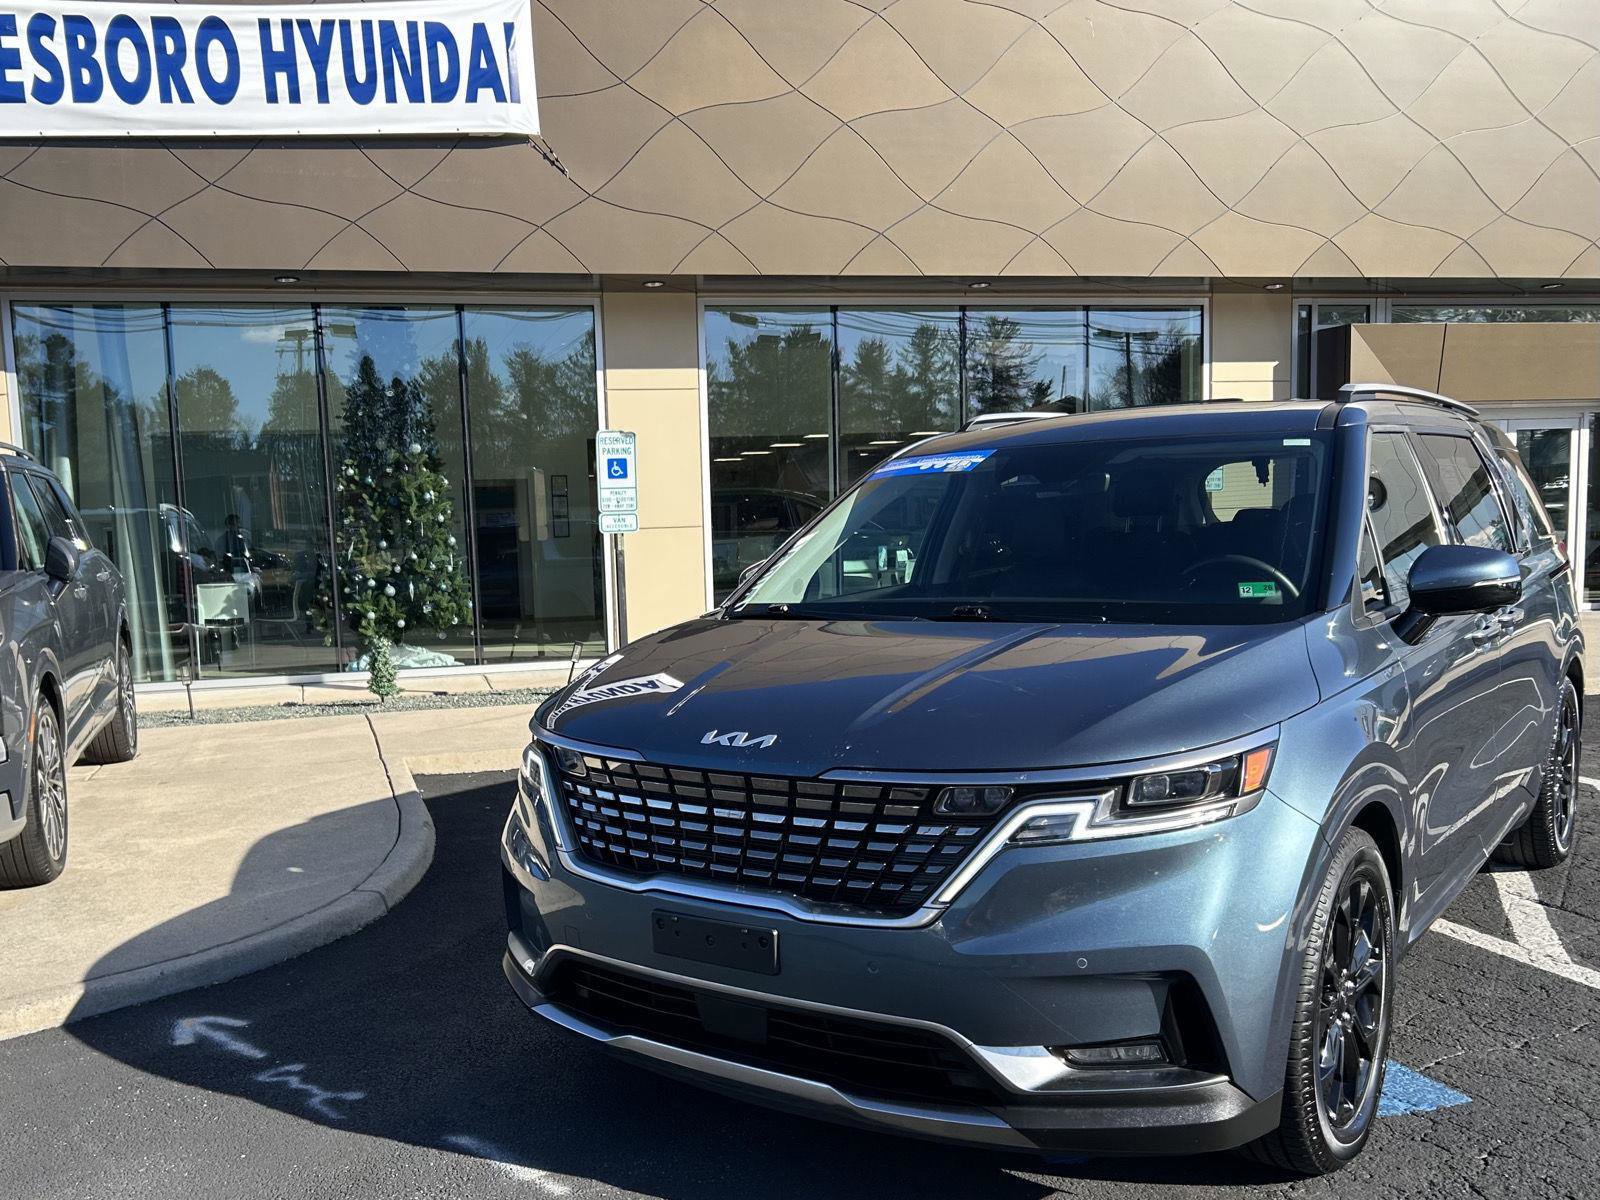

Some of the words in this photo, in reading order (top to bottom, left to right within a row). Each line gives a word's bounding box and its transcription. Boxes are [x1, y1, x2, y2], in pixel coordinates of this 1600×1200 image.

[0, 12, 241, 105] ESBORO
[258, 17, 521, 105] HYUNDAI
[599, 436, 634, 445] RESERVED
[602, 447, 632, 456] PARKING
[1241, 586, 1252, 594] 12
[700, 729, 778, 749] KIA
